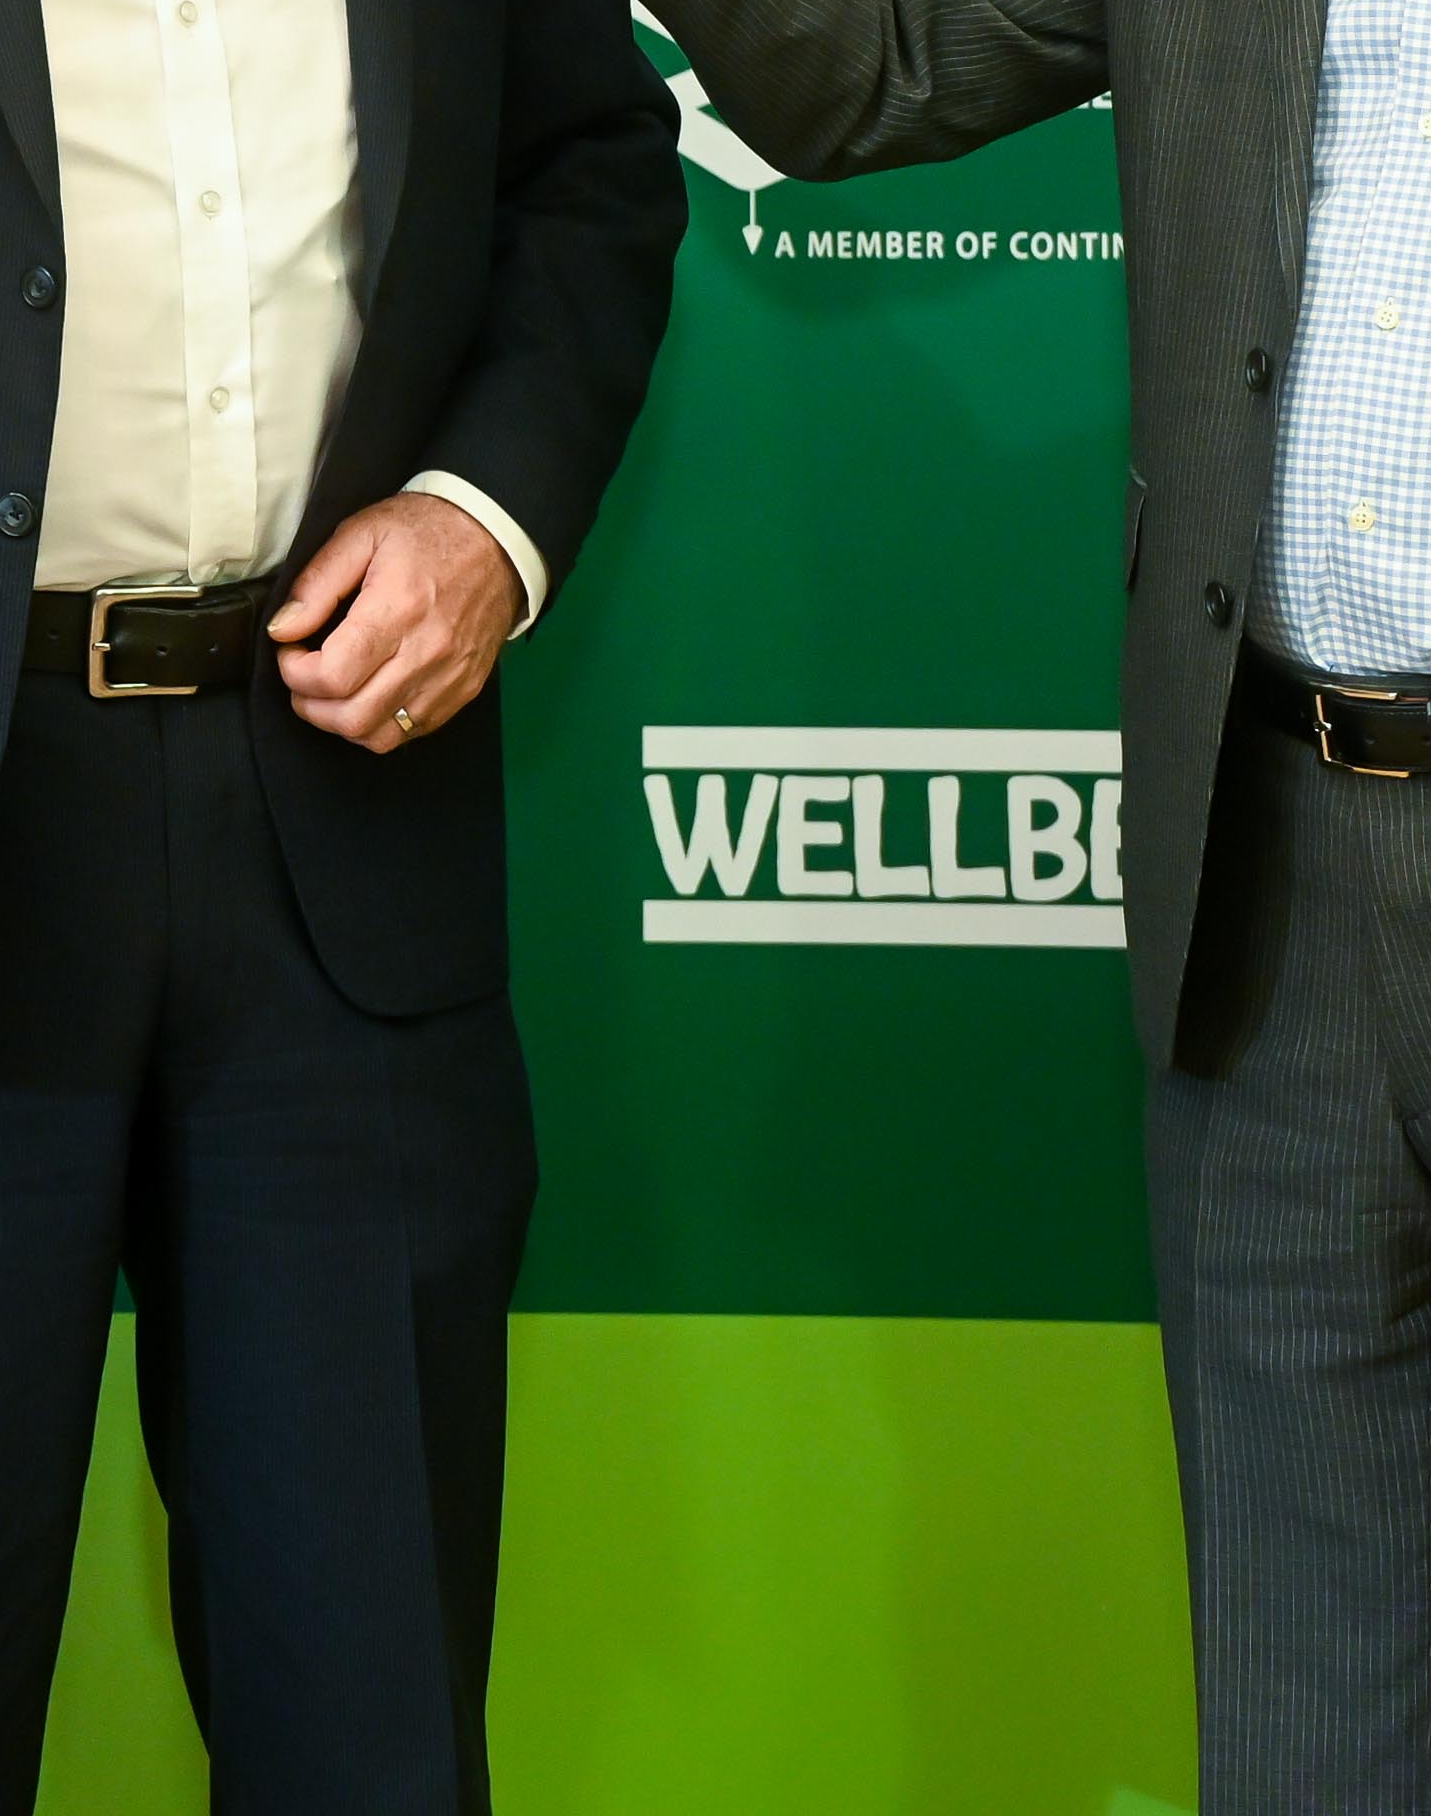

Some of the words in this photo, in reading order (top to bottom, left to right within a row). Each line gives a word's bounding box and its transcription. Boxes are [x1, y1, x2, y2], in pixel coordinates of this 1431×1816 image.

[775, 231, 796, 259] A
[806, 231, 945, 260] MEMBER
[955, 231, 998, 260] OF
